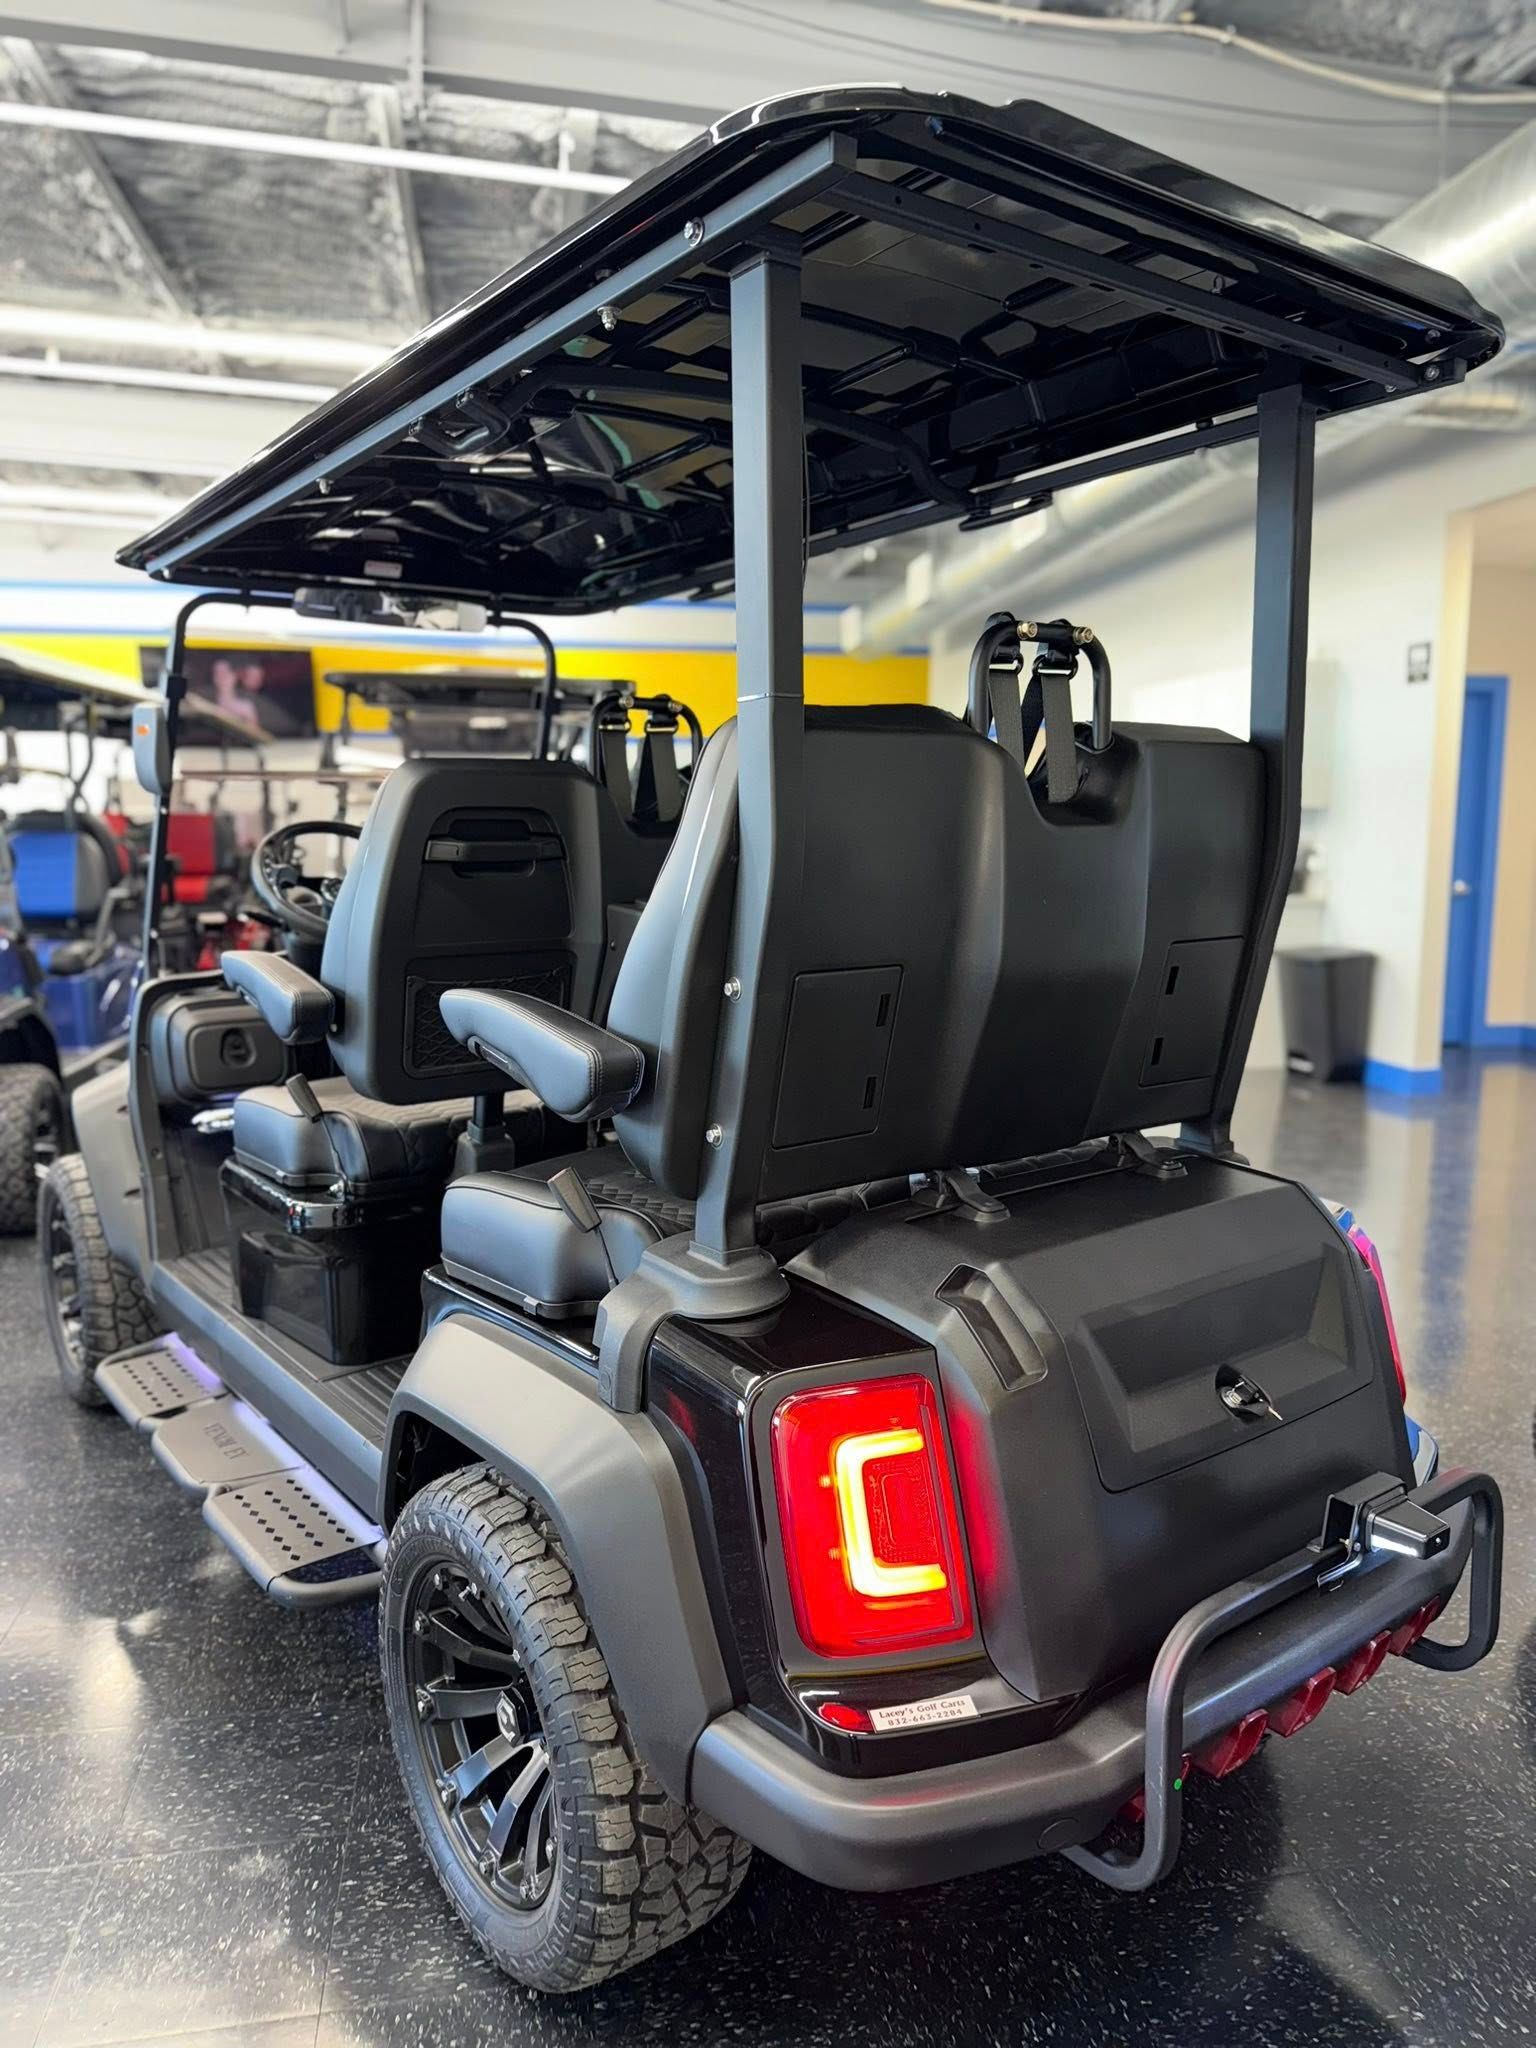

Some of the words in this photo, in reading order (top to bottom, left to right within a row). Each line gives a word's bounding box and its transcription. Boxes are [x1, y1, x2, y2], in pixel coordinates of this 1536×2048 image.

[879, 1707, 913, 1718] Lacey's
[917, 1703, 937, 1712] Golf
[940, 1699, 965, 1708] Carts
[888, 1708, 963, 1726] 832-663-2284
